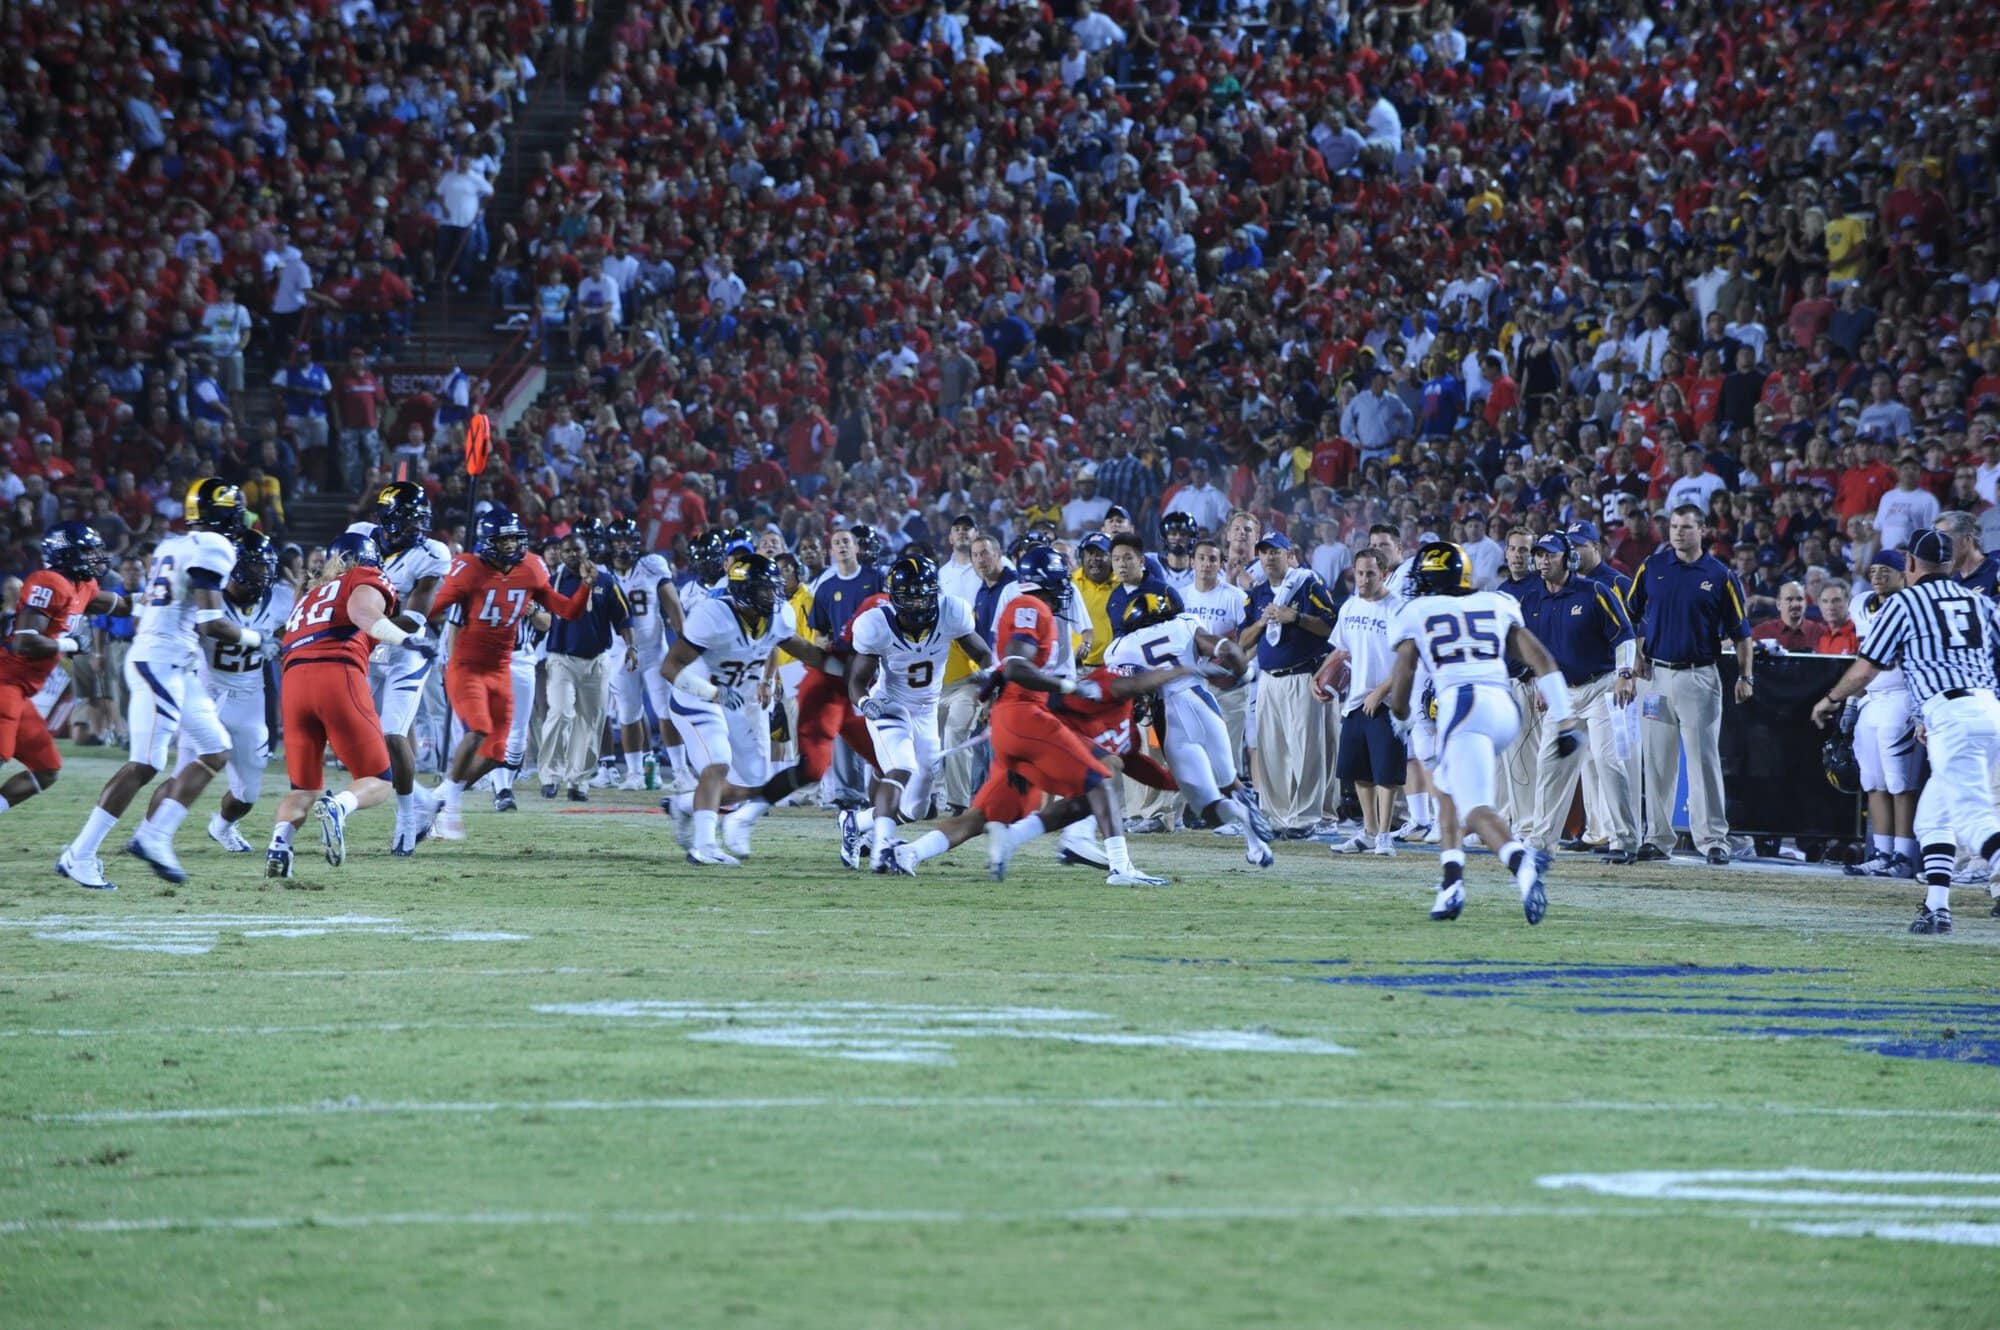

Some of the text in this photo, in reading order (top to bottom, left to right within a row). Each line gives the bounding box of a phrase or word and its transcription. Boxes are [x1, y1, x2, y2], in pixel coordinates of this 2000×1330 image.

[147, 555, 174, 607] 6
[1421, 549, 1451, 571] Cal
[285, 579, 342, 633] 42
[478, 588, 527, 628] 47
[1937, 600, 1971, 647] F
[1141, 635, 1185, 669] 5
[1425, 610, 1500, 668] 25
